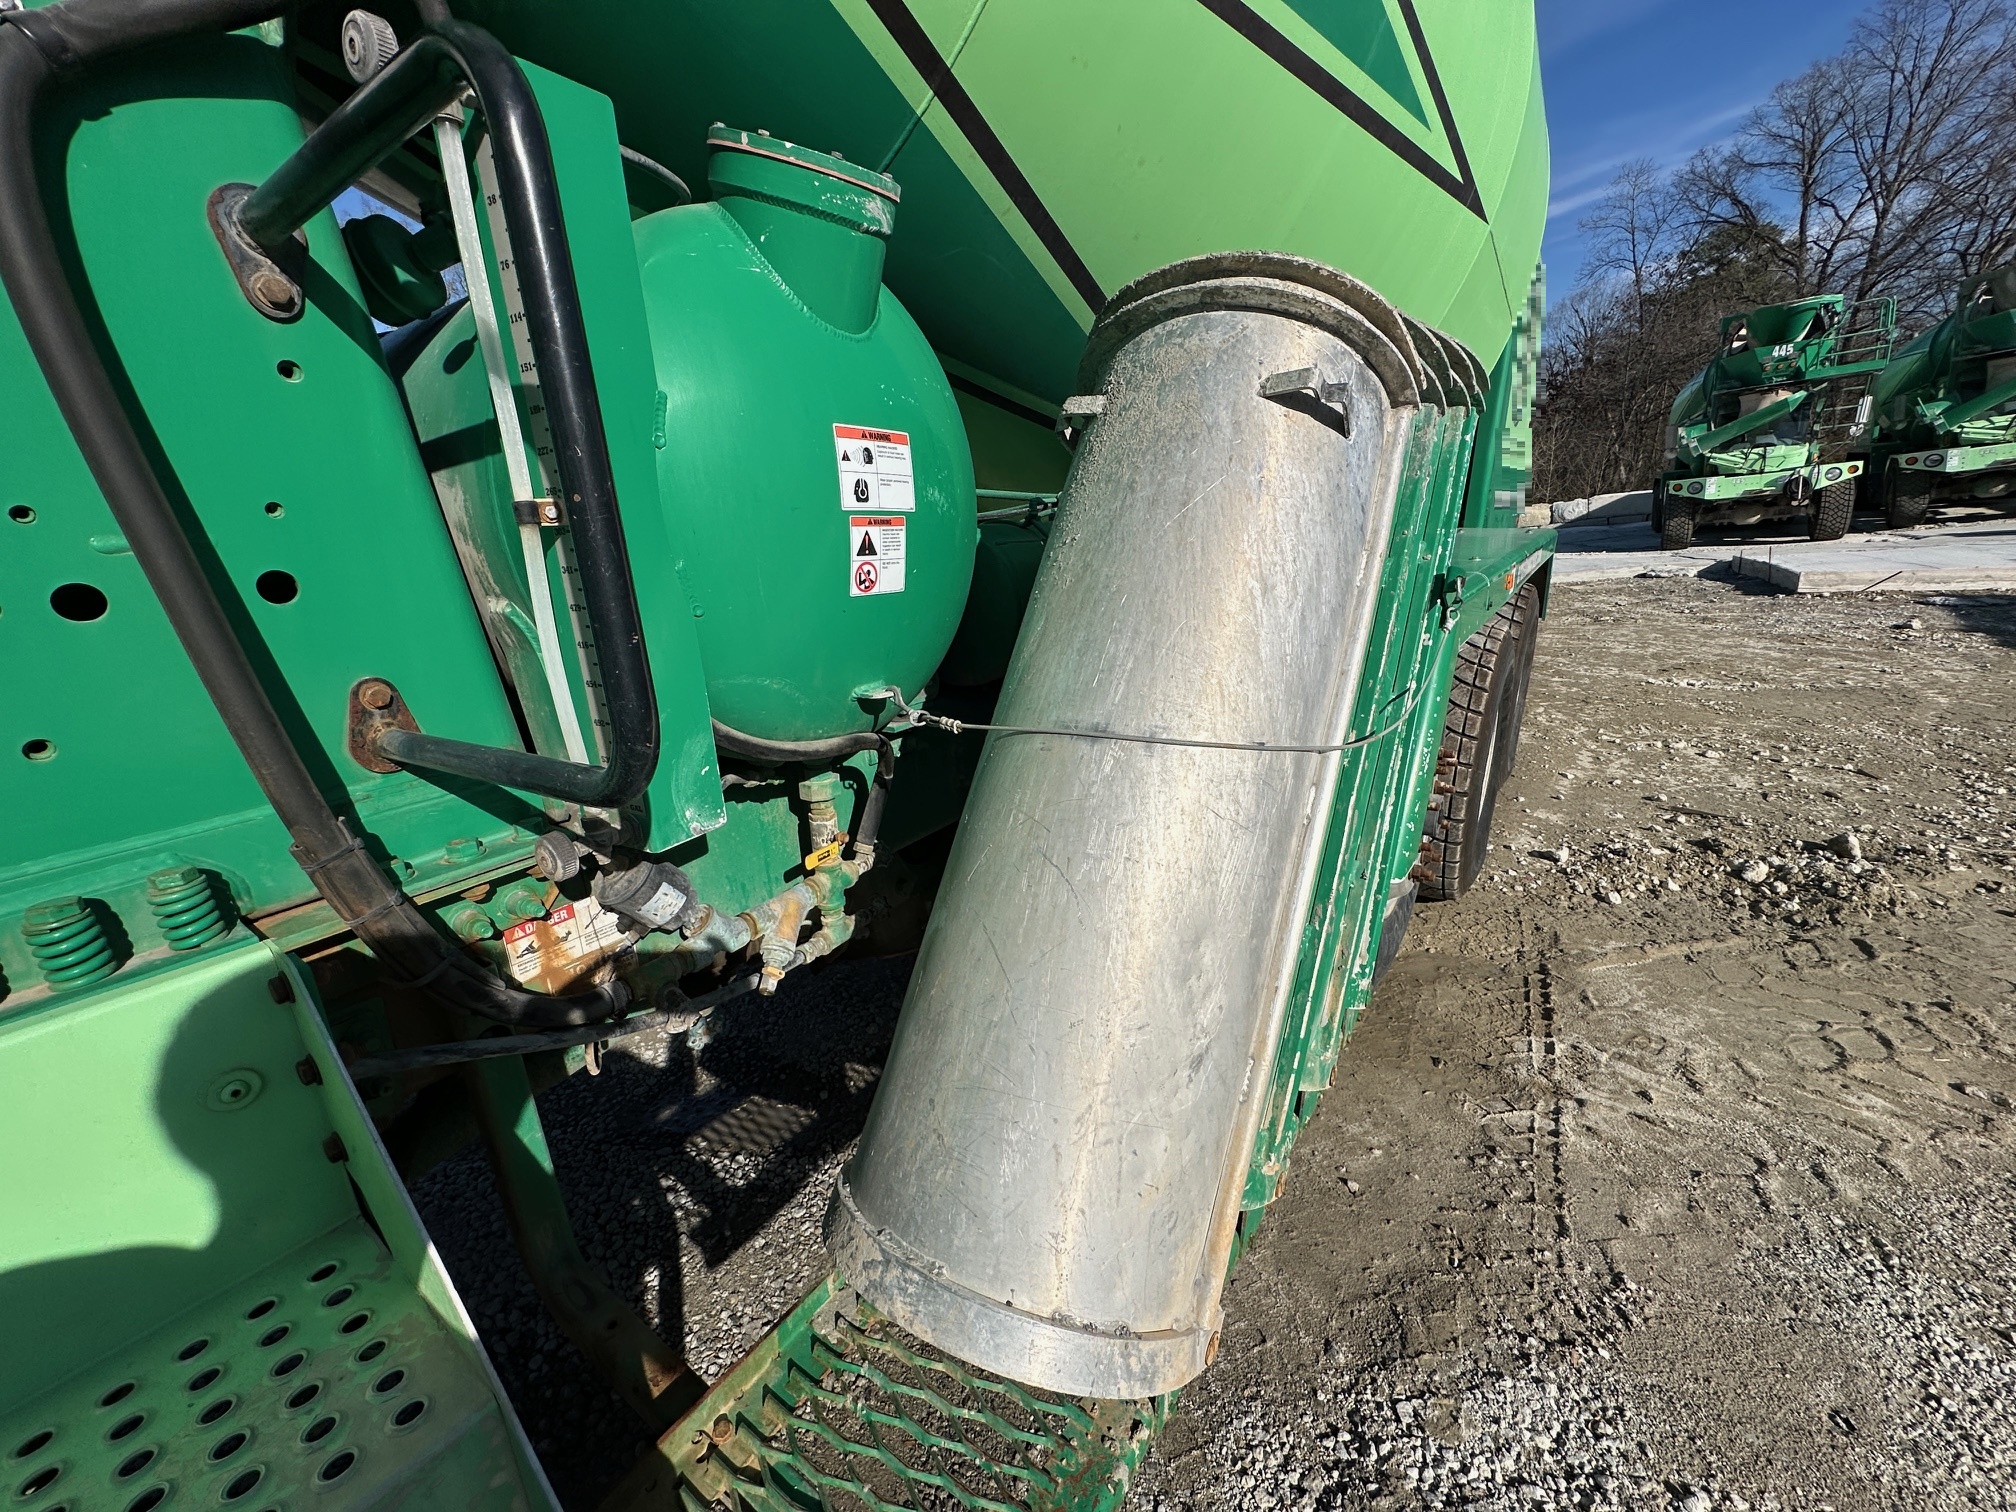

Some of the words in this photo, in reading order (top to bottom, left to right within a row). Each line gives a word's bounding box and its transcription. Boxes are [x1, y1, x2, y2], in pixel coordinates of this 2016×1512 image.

[487, 194, 497, 206] 38
[500, 260, 510, 270] 76
[510, 312, 523, 324] 114
[1772, 343, 1794, 357] 445
[520, 362, 533, 373] 151
[868, 432, 891, 442] WARNING
[537, 446, 549, 456] 227
[562, 566, 574, 574] 341
[577, 641, 589, 649] 416
